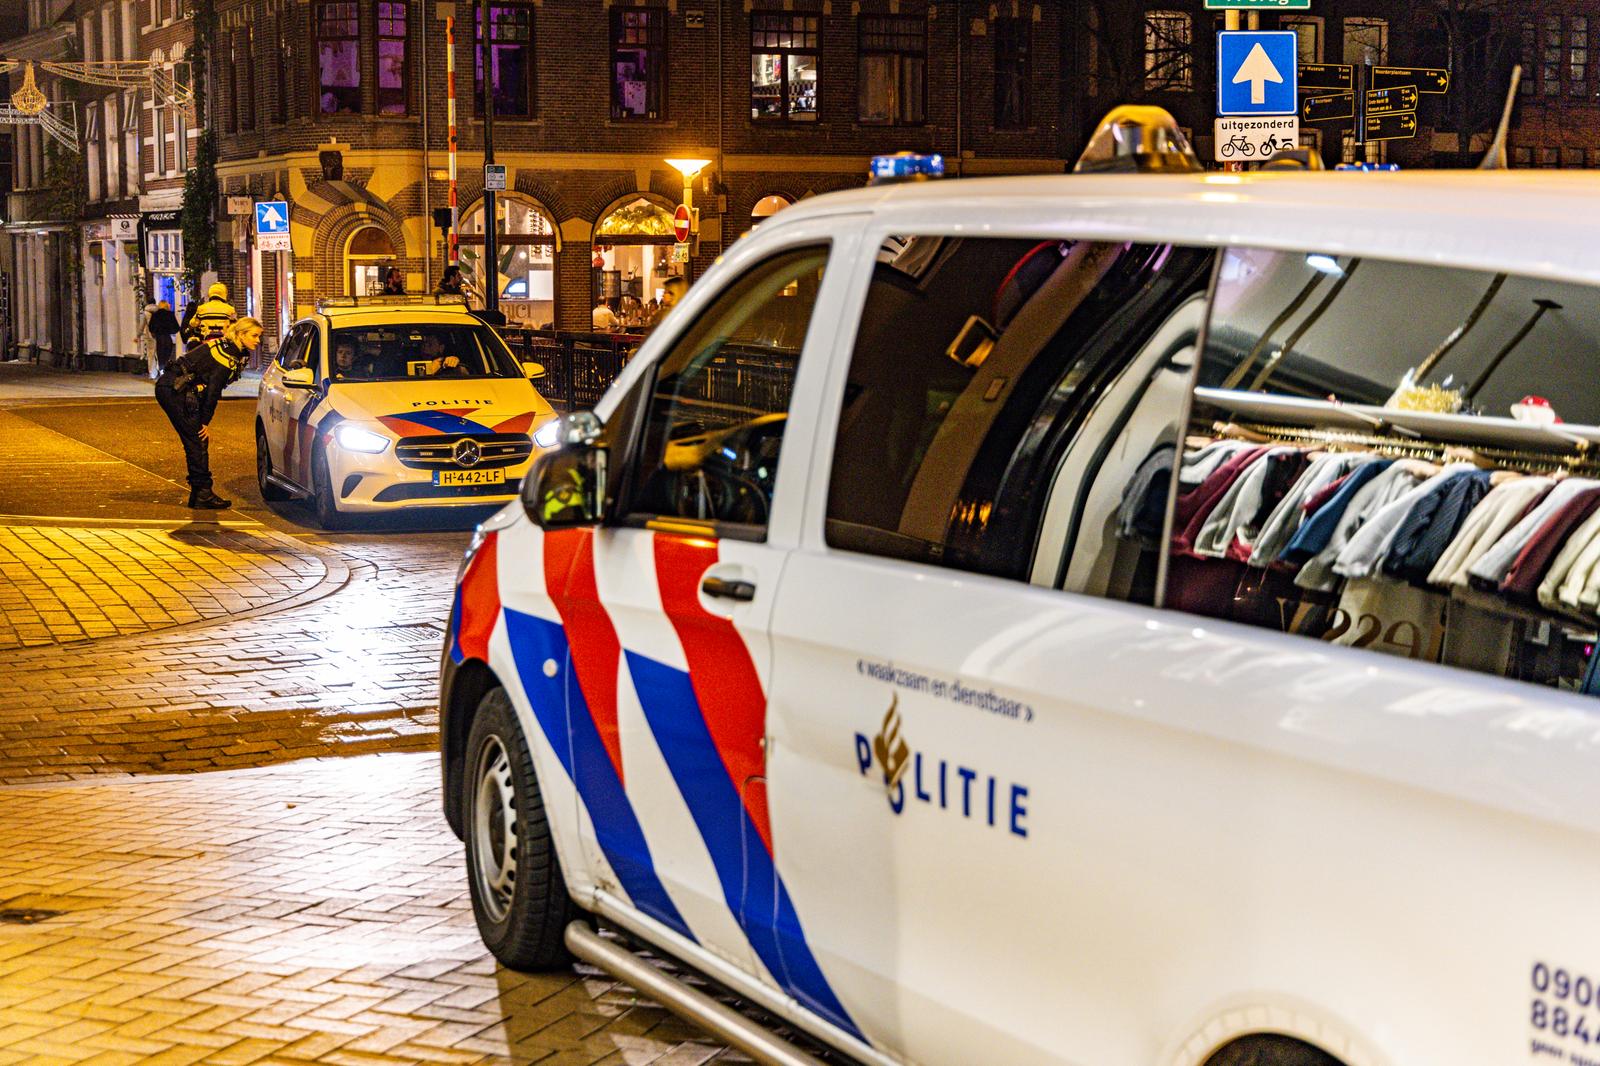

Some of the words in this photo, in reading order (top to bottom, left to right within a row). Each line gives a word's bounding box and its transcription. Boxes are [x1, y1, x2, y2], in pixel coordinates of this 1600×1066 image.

[1221, 119, 1294, 132] uitgezonderd
[412, 399, 494, 407] POLITIE
[867, 661, 929, 693] waakzaam
[931, 679, 947, 698] en
[950, 679, 1022, 719] dienstbaar
[854, 731, 1030, 838] POLITIE
[1531, 961, 1600, 1012] 090
